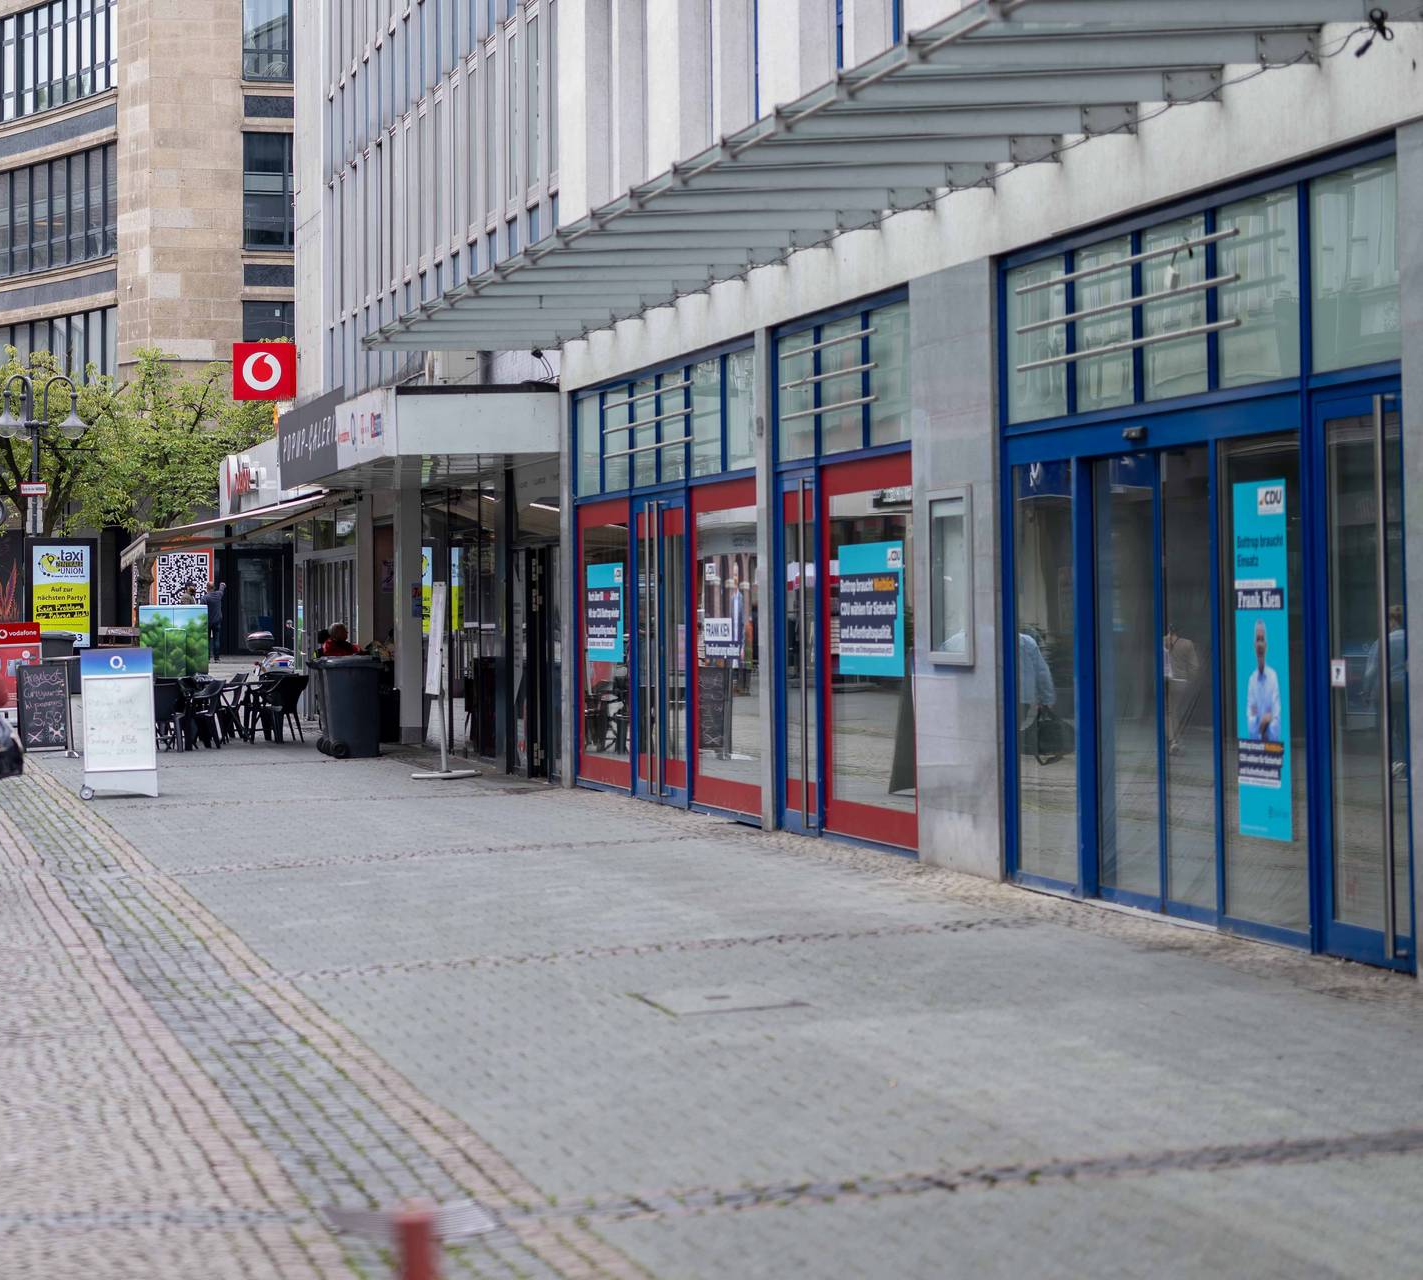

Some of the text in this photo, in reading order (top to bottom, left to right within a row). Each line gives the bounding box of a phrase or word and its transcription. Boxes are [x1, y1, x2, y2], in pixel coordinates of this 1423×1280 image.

[1265, 490, 1282, 505] CDU
[60, 549, 83, 561] taxi
[1238, 591, 1281, 608] Frank Kien
[8, 629, 37, 637] vodafone
[705, 622, 730, 638] FRANK KIEN
